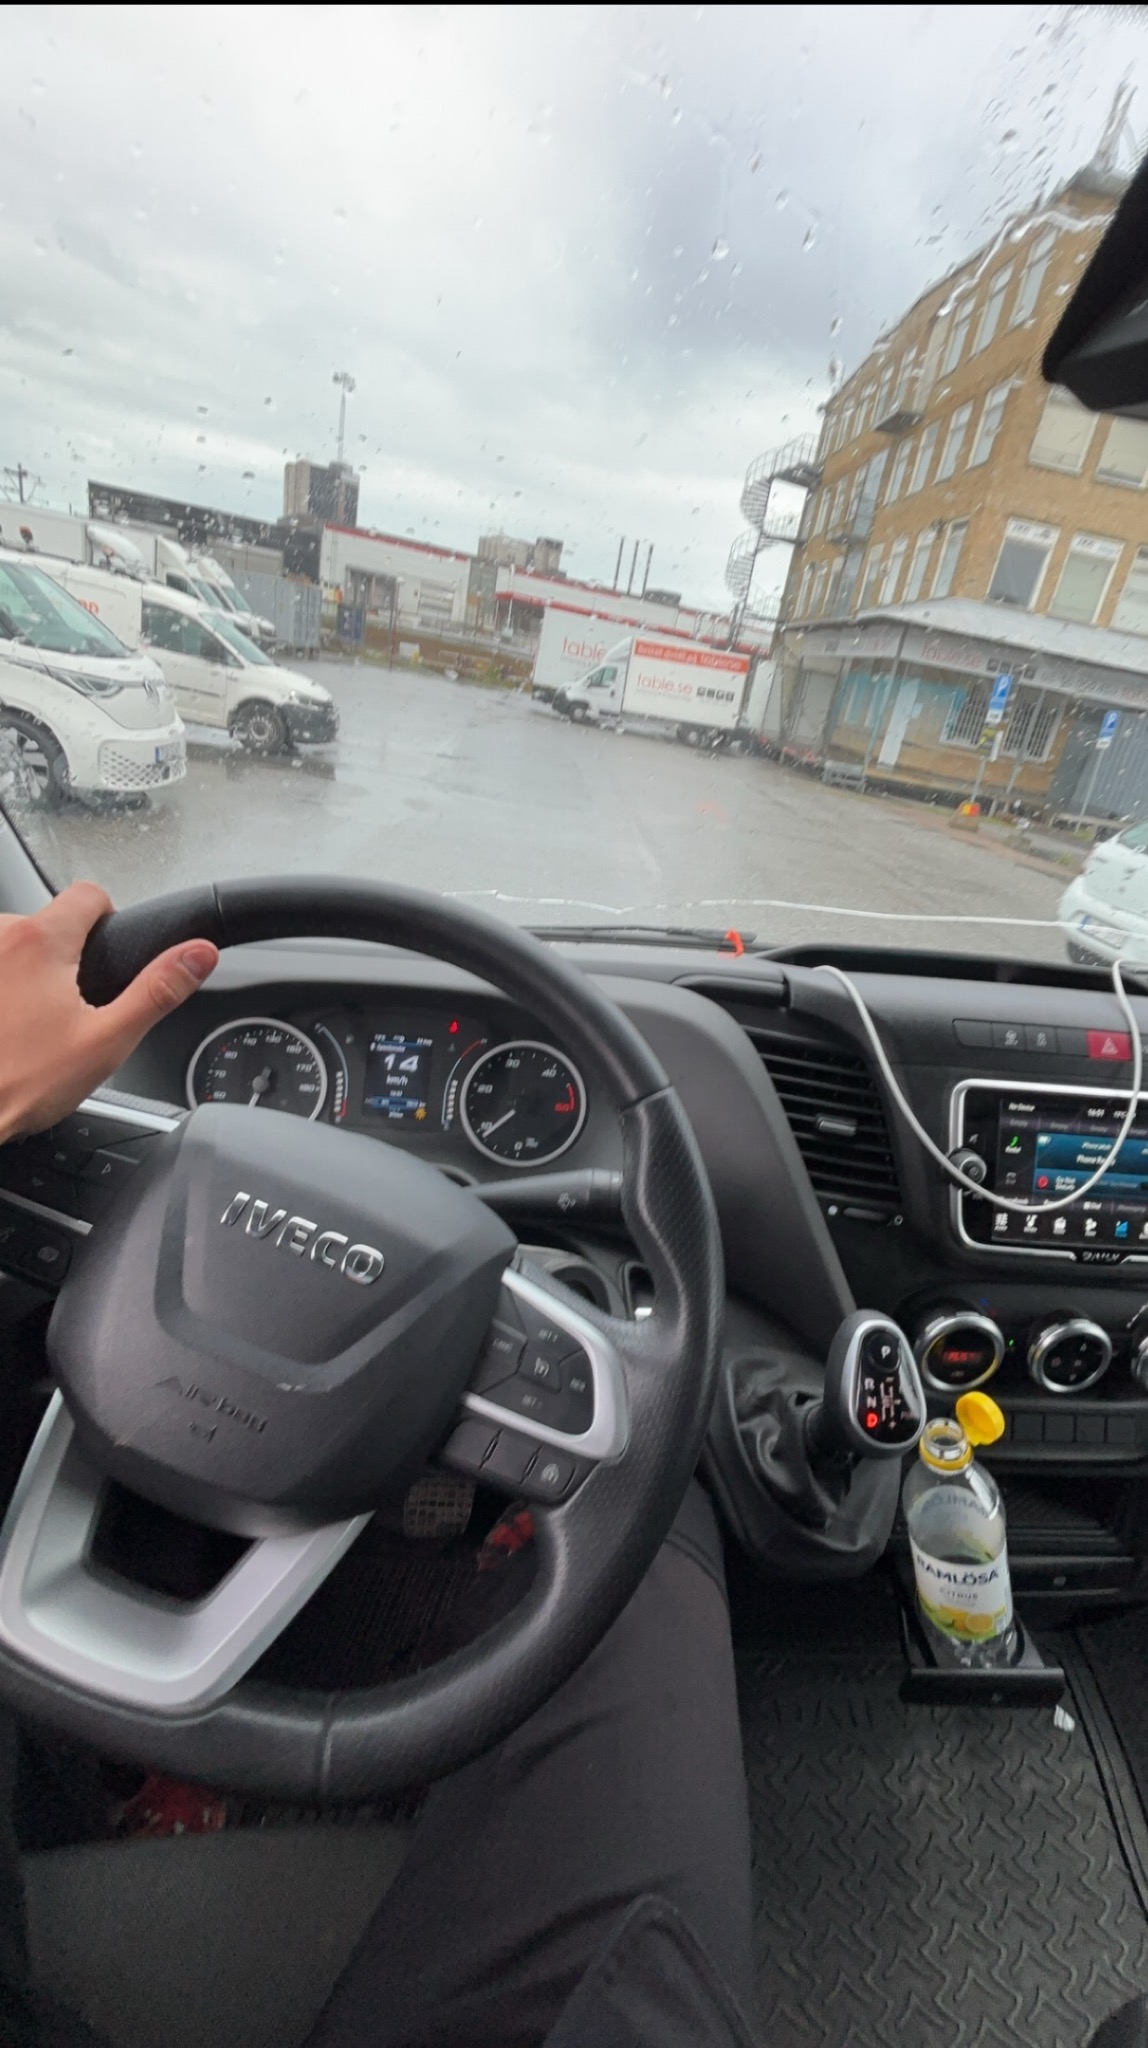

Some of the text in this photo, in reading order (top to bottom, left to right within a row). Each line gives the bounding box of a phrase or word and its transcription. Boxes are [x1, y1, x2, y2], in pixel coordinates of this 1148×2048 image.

[637, 673, 693, 695] table.se
[384, 1053, 420, 1073] 14
[541, 1068, 558, 1078] 40
[386, 1074, 408, 1087] km/h
[220, 1191, 385, 1286] IVECO
[881, 1345, 891, 1359] P
[864, 1377, 875, 1391] R
[867, 1396, 877, 1409] N
[866, 1412, 878, 1428] D
[916, 1553, 999, 1586] RAMLÖSA
[939, 1587, 978, 1600] CITRUS
